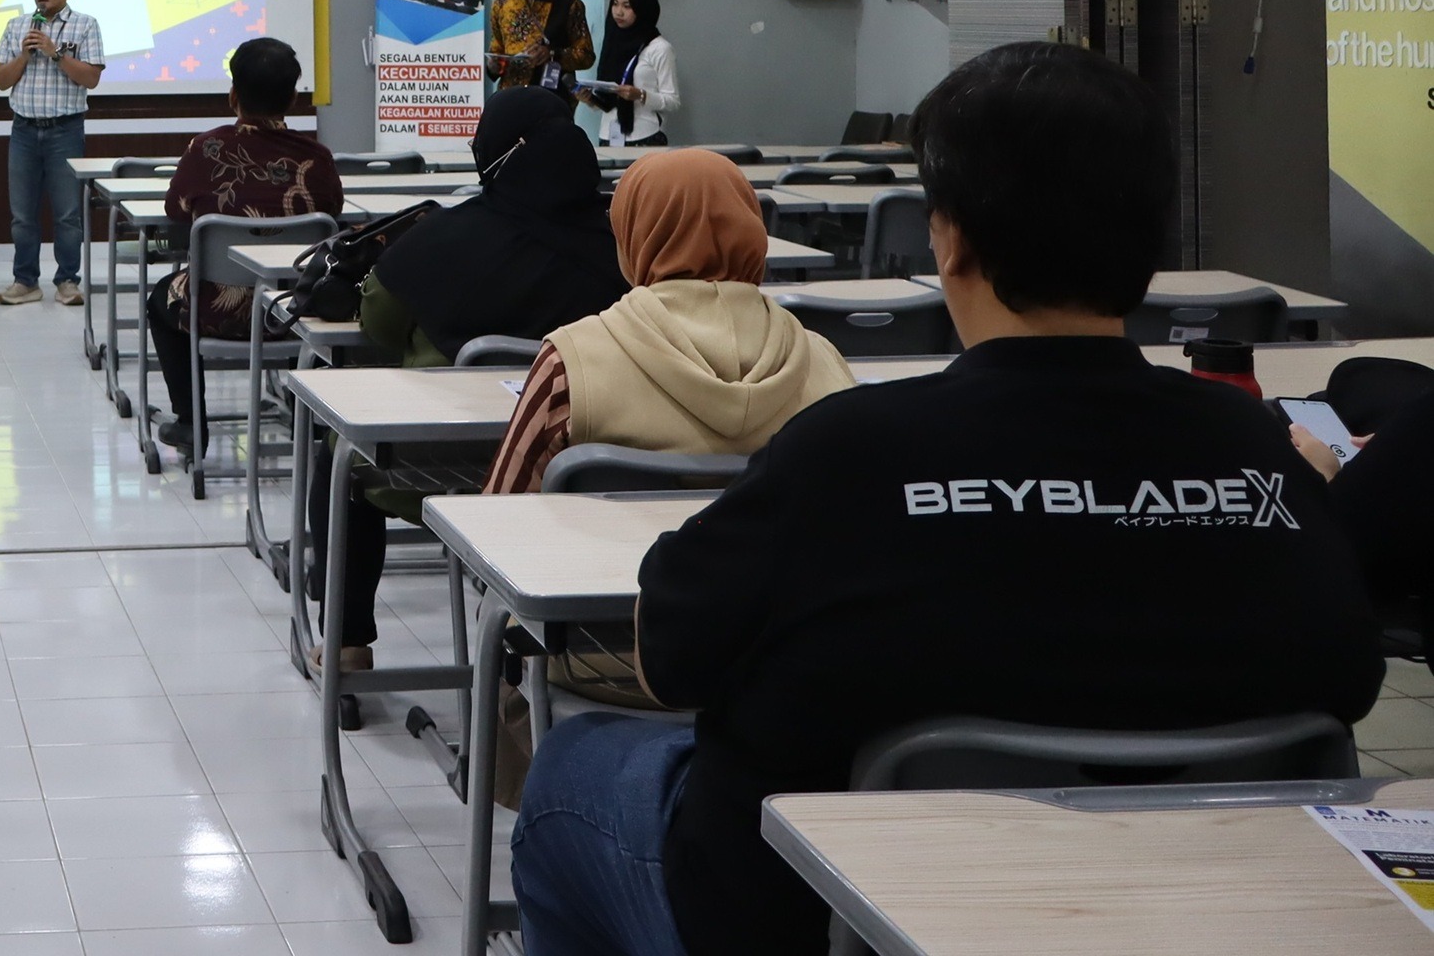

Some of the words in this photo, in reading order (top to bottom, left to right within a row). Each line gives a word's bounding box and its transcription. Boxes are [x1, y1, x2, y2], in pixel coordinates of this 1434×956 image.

[1326, 30, 1351, 67] of
[1352, 31, 1394, 68] the
[1396, 30, 1434, 69] hu
[380, 54, 421, 63] SEGALA
[424, 54, 466, 63] BENTUK
[380, 67, 480, 79] KECURANGAN
[380, 82, 415, 91] DALAM
[419, 82, 449, 91] UJIAN
[380, 95, 408, 104] AKAN
[412, 95, 470, 104] BERAKIBAT
[380, 108, 441, 118] KEGAGALAN
[444, 108, 481, 118] KULIAH
[380, 124, 415, 133] DALAM
